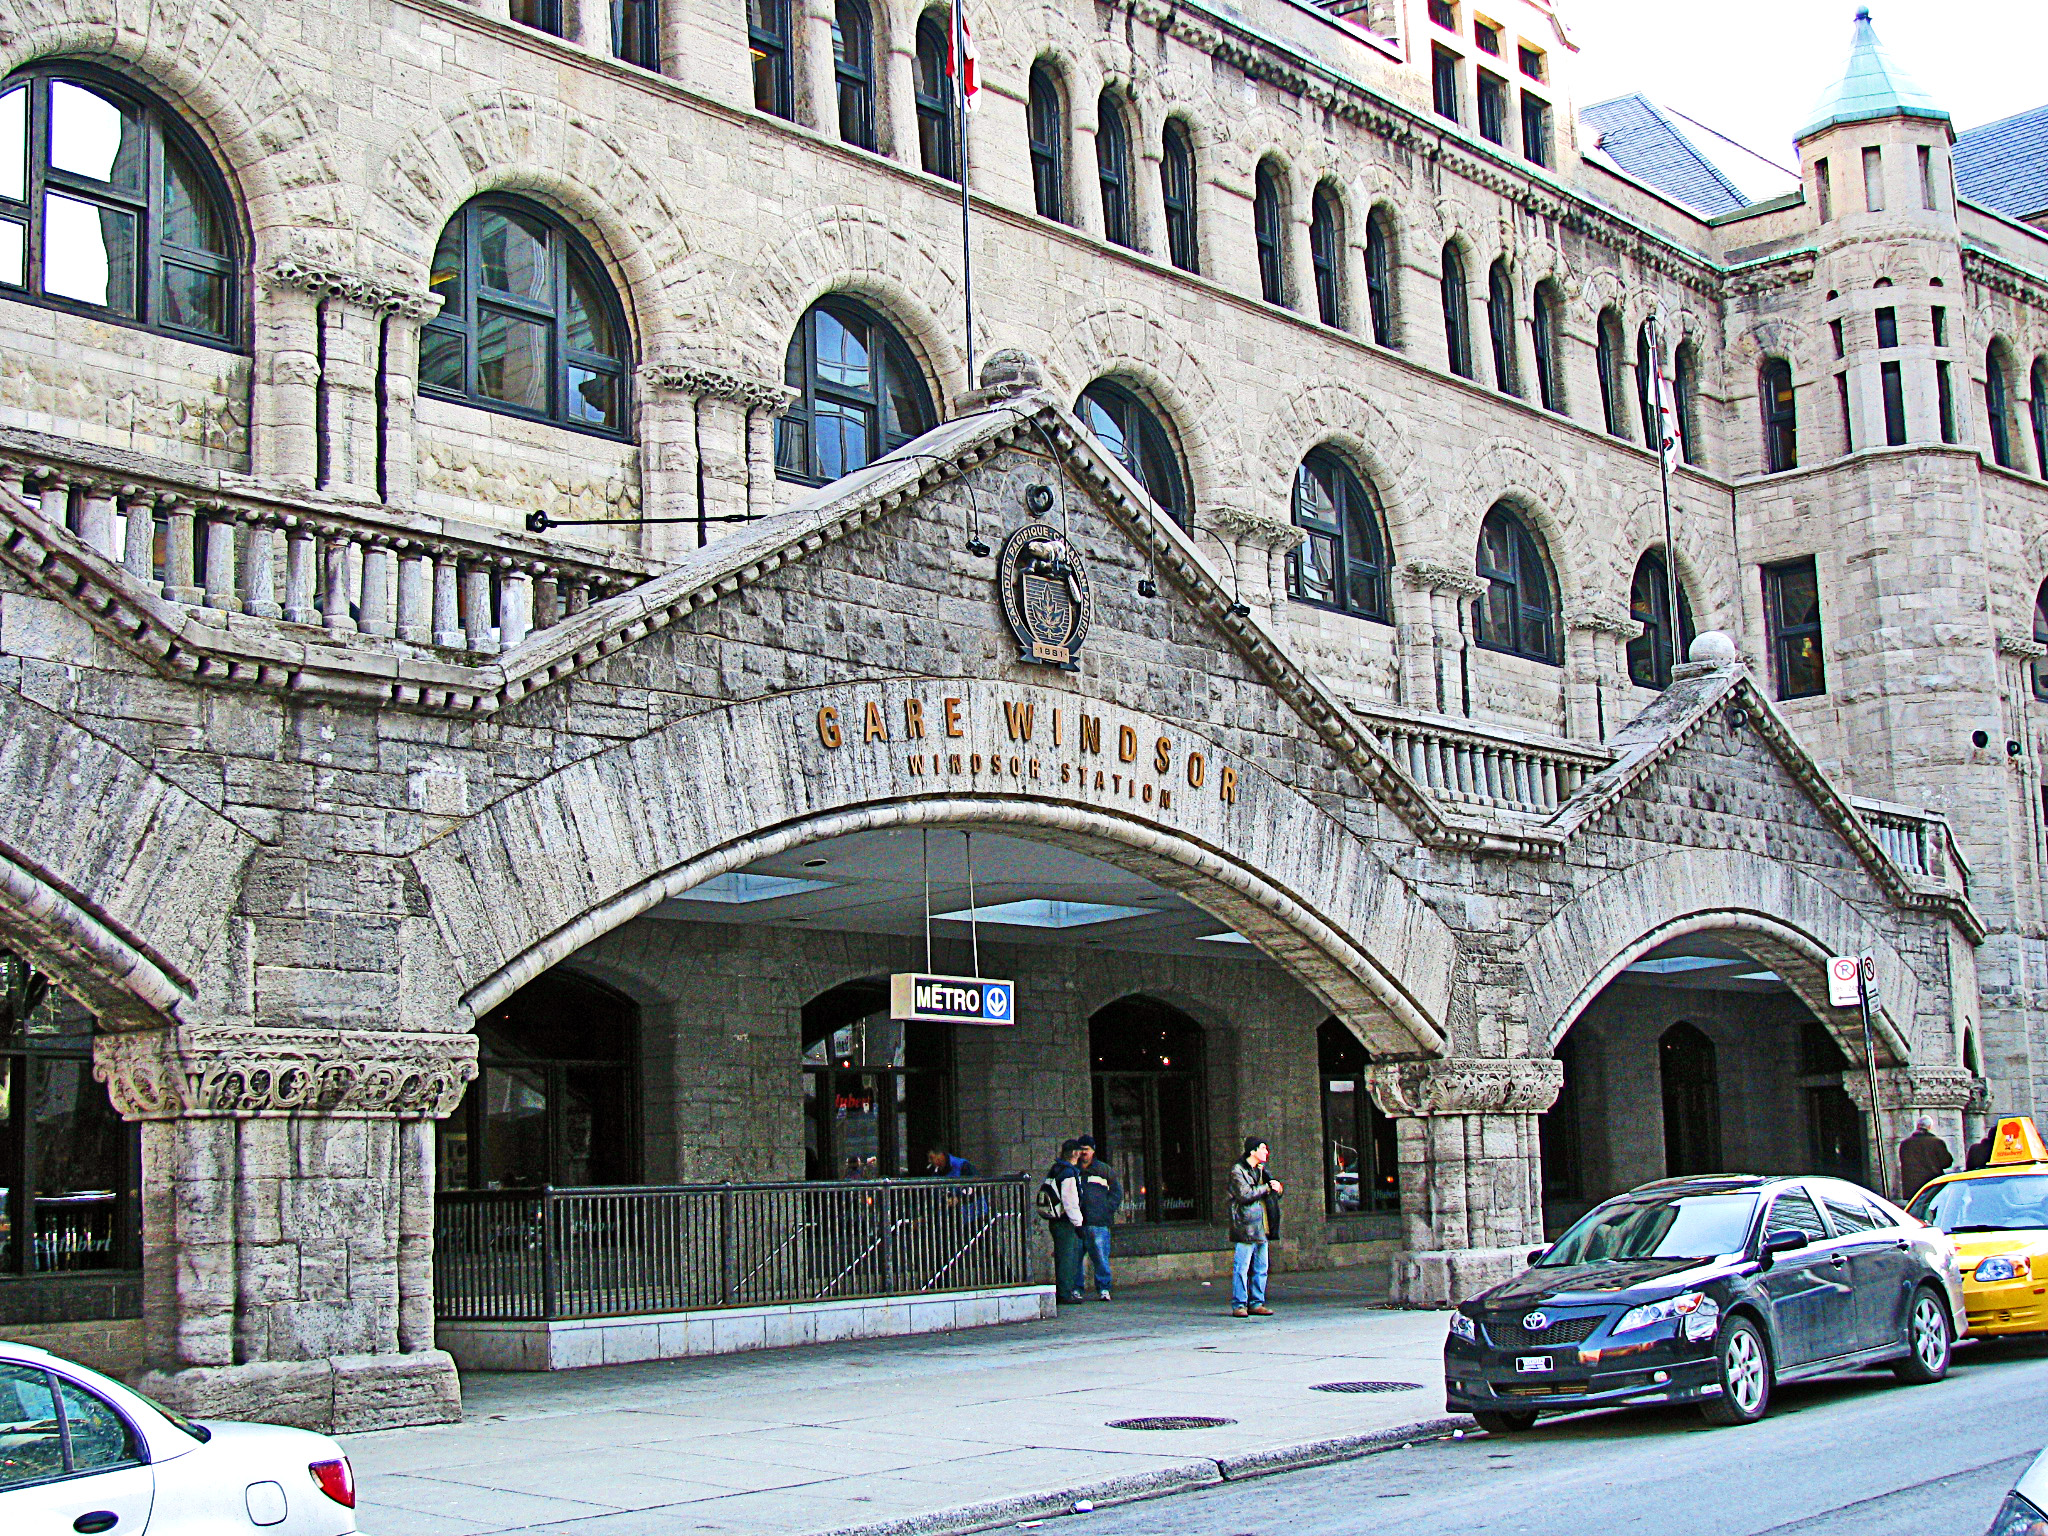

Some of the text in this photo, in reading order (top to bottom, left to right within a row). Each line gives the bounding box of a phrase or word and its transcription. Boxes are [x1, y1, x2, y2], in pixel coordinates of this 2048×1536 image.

[1004, 526, 1049, 627] CANADIEN PACIFIQUE
[1053, 532, 1090, 640] CANADIAN PACIFIC
[818, 697, 1238, 804] GARE WINDSOR
[908, 753, 1171, 809] WINDSOR STATION
[916, 983, 980, 1012] MÉTRO
